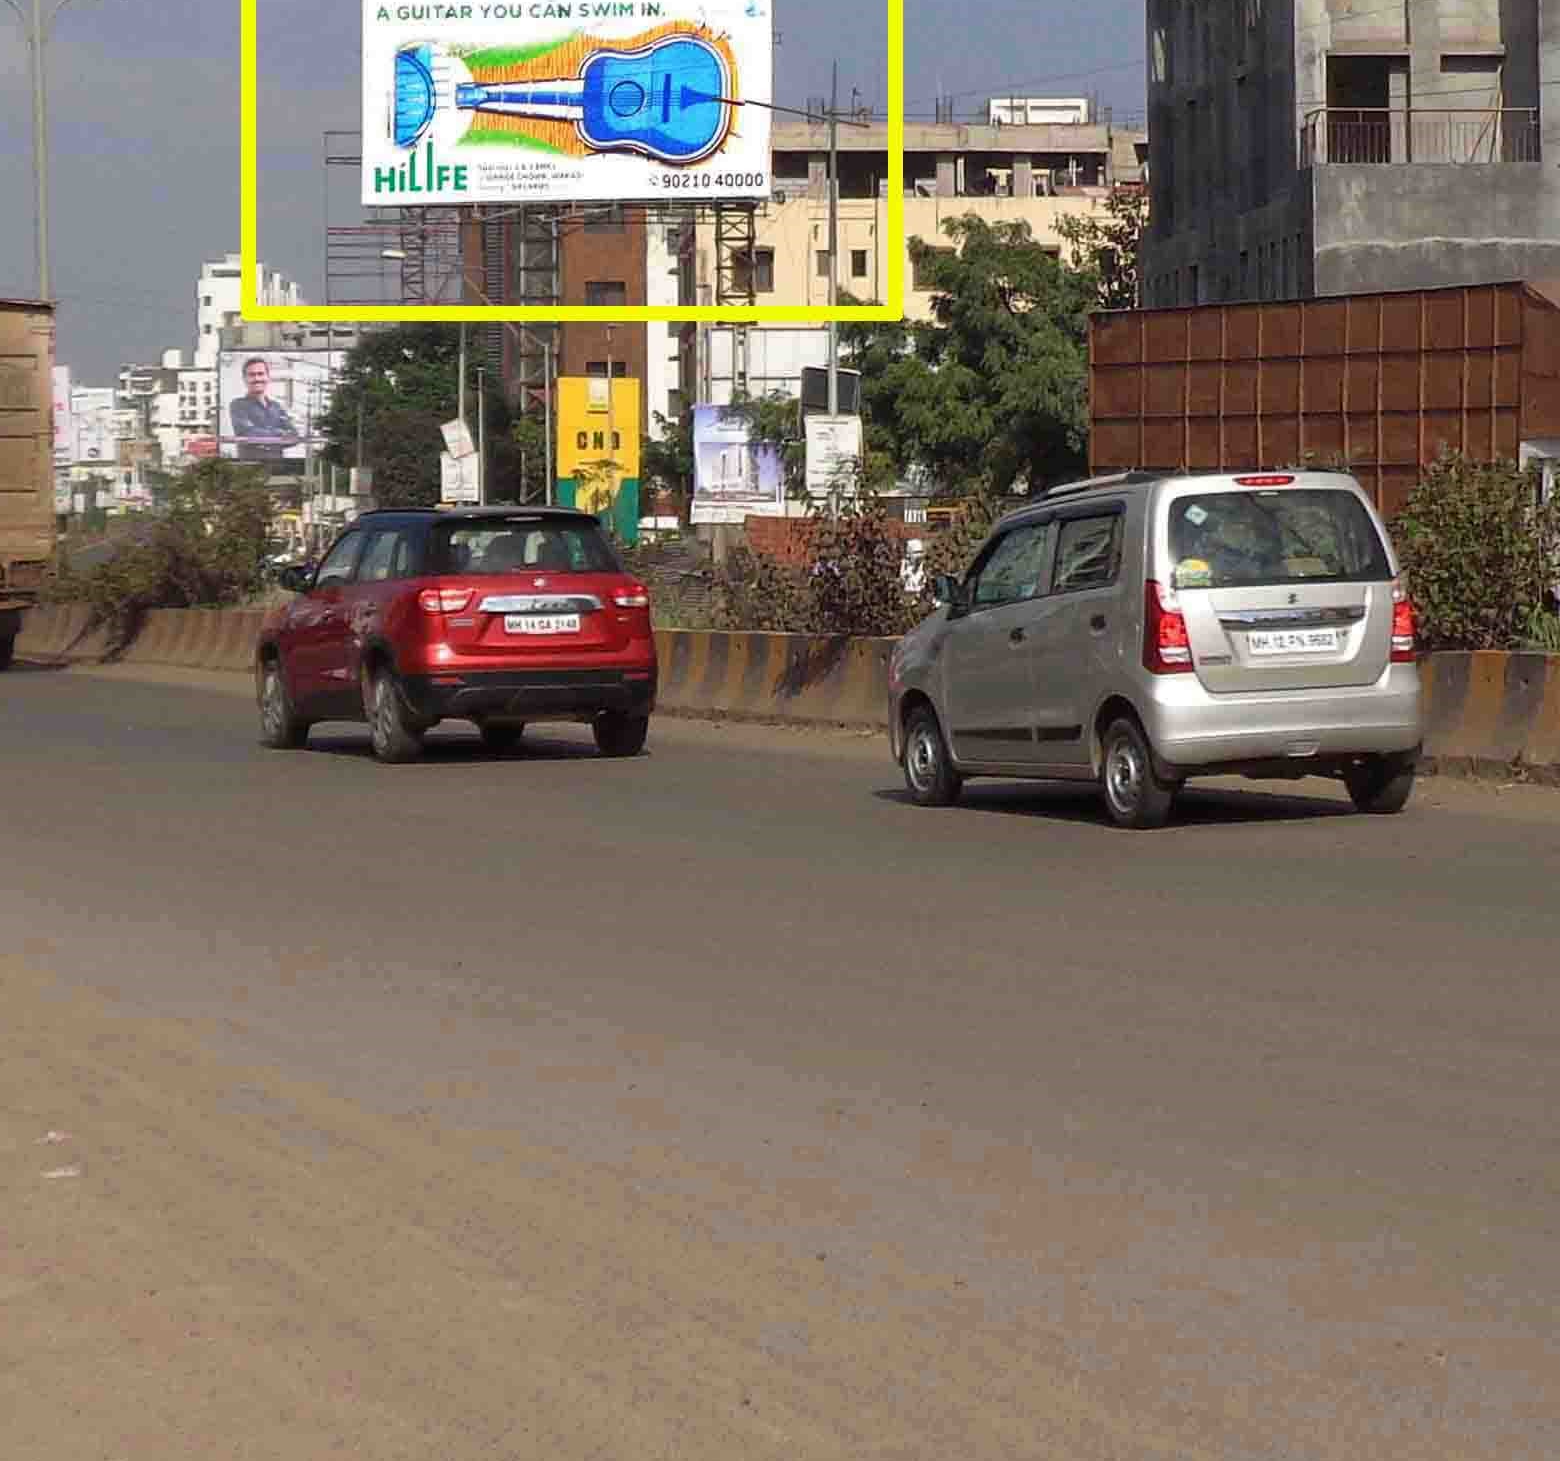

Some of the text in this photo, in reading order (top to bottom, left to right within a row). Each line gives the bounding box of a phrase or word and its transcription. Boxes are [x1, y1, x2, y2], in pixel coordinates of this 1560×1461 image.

[376, 2, 667, 21] A GUITAR YOU CAN SWIM IN.
[662, 172, 764, 189] 90210 40000
